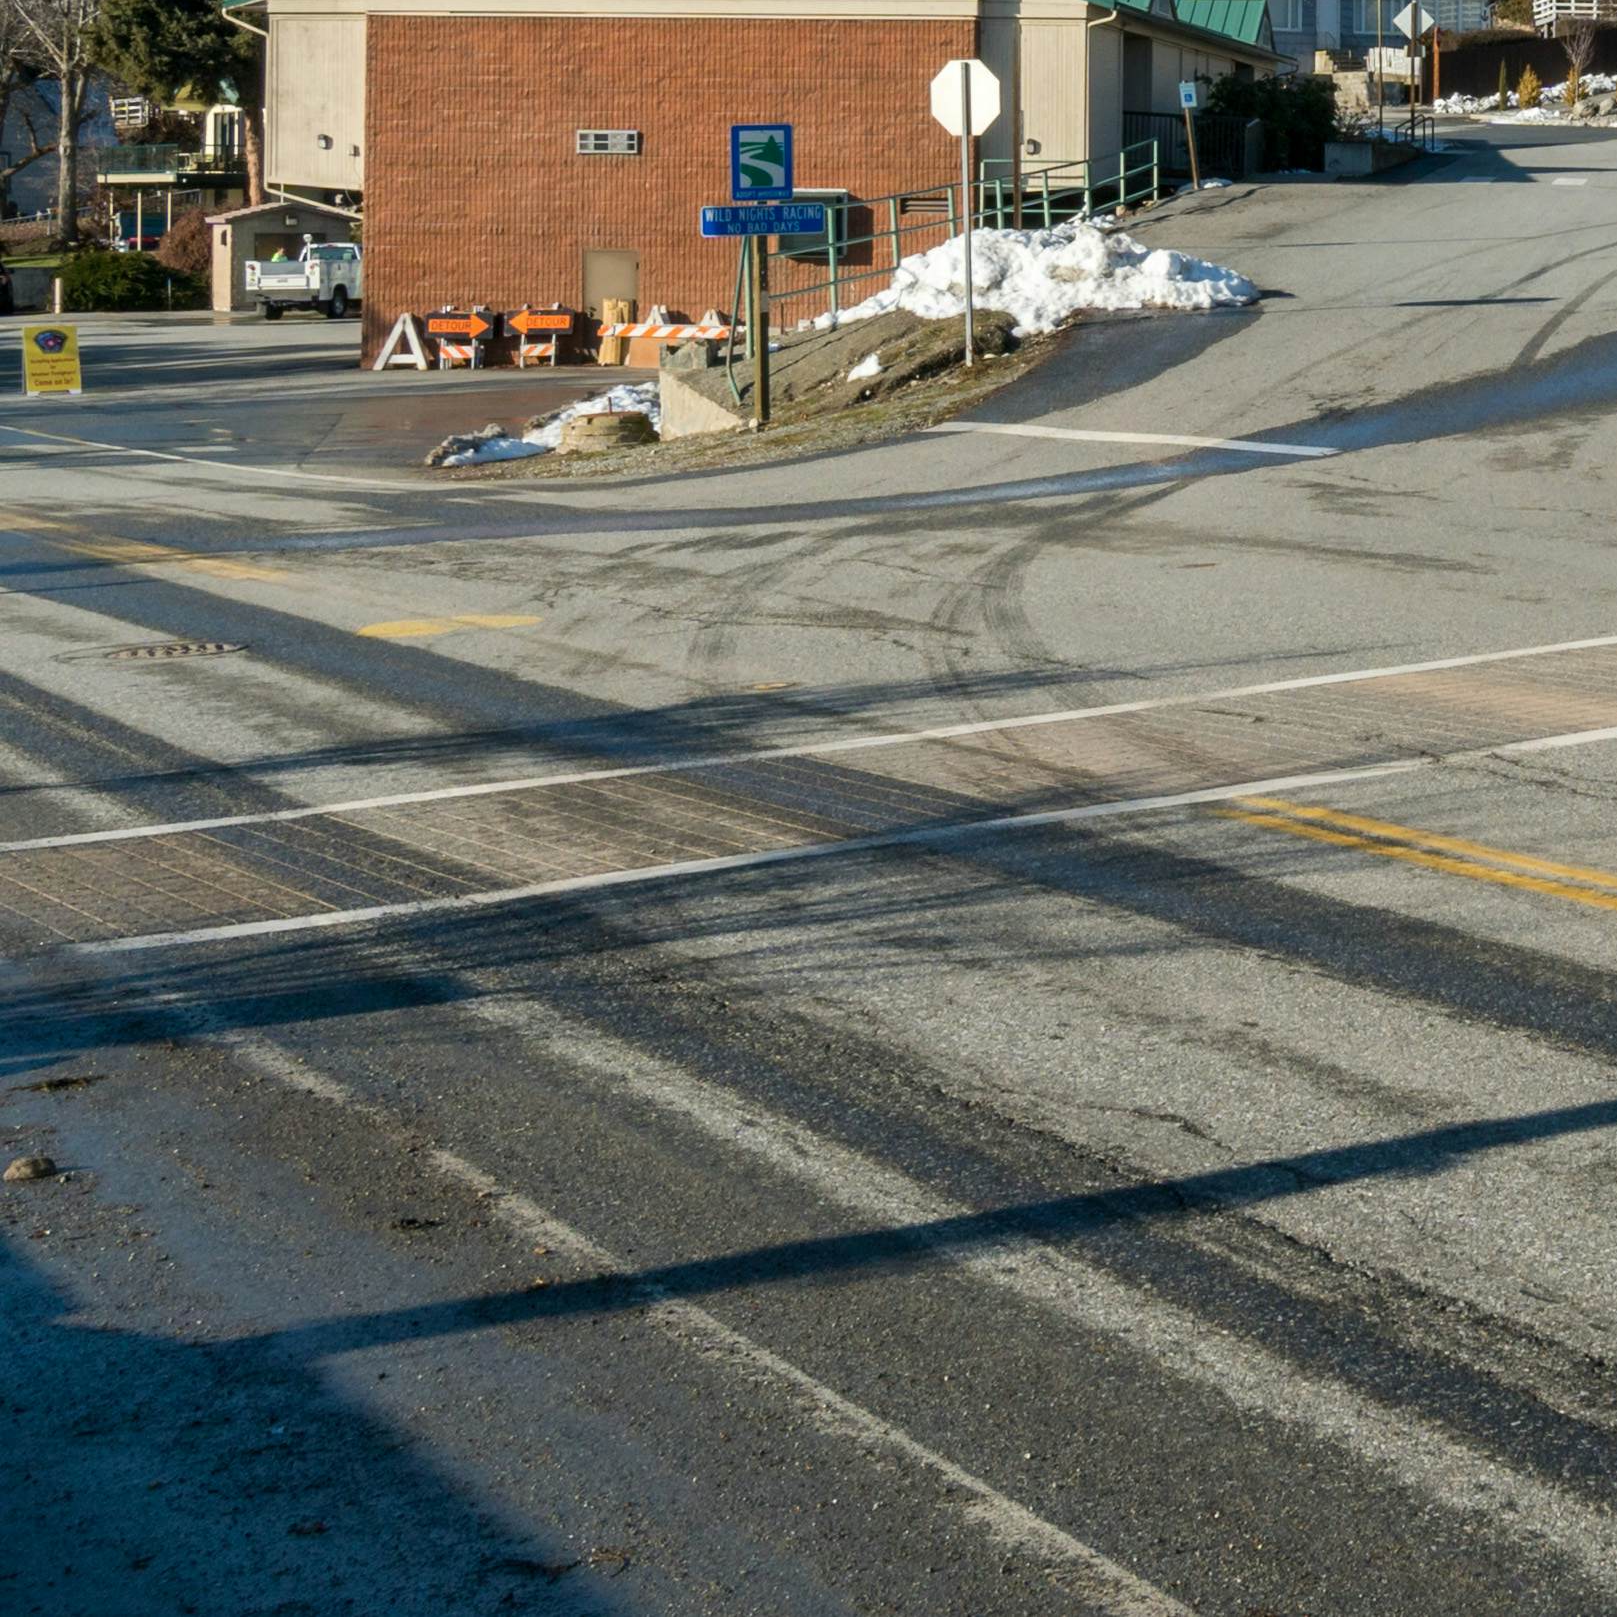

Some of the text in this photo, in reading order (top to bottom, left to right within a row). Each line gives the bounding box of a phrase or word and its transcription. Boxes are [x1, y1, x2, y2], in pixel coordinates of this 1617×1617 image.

[704, 205, 821, 223] WILD NIGHTS RACING
[727, 221, 800, 233] NO BAD DAYS
[431, 320, 472, 331] DETOUR
[526, 316, 567, 327] DETOUR
